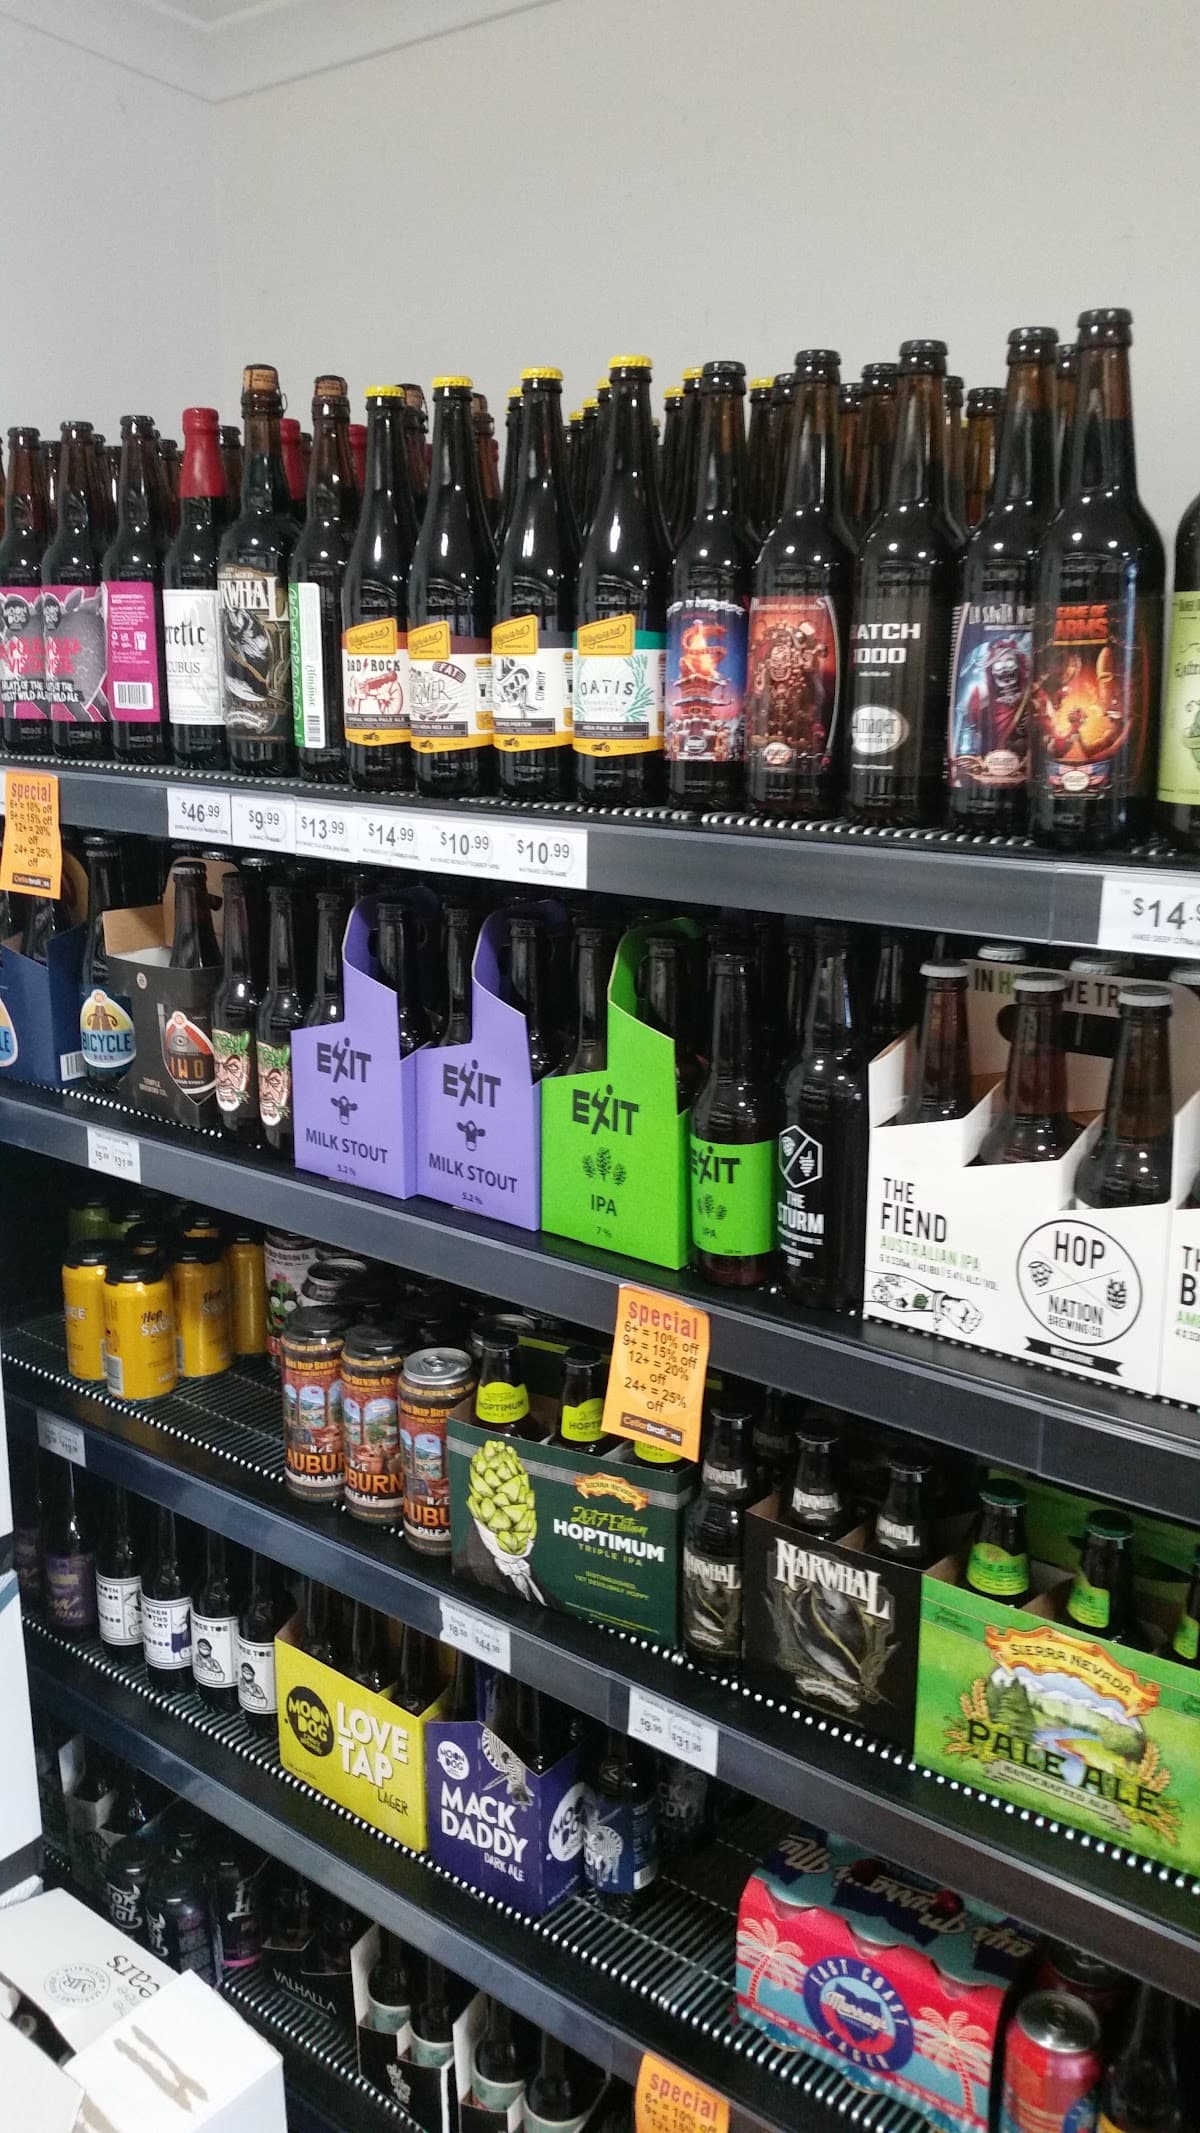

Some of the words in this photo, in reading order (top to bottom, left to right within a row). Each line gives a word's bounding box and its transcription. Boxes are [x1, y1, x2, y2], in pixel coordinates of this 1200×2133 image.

[219, 575, 290, 622] RWHAL
[370, 658, 401, 672] ROCK
[580, 679, 635, 696] OATIS
[11, 781, 51, 803] special
[42, 804, 52, 815] off
[42, 816, 53, 826] off
[181, 801, 221, 823] $46.99
[248, 809, 280, 831] $9.99
[28, 836, 39, 846] off
[301, 816, 345, 839] $13.99
[368, 822, 415, 847] $14.99
[14, 843, 28, 854] 24+
[440, 831, 490, 856] $10.99
[516, 839, 570, 865] $10.99
[28, 858, 39, 867] off
[975, 967, 994, 993] IN
[81, 1032, 132, 1053] BICYCLE
[316, 1037, 372, 1083] EXIT
[442, 1059, 502, 1108] EXIT
[571, 1084, 641, 1136] EXIT
[305, 1127, 340, 1151] MILK
[341, 1138, 388, 1164] STOUT
[428, 1152, 465, 1178] MILK
[467, 1164, 518, 1193] STOUT
[590, 1194, 618, 1217] IPA
[786, 1189, 806, 1209] THE
[882, 1177, 915, 1204] THE
[880, 1202, 947, 1243] FIEND
[880, 1235, 957, 1265] AUSTRALIAN
[1053, 1230, 1105, 1269] HOP
[628, 1300, 698, 1340] special
[1048, 1314, 1089, 1334] BREWING
[1049, 1294, 1104, 1325] NATION
[623, 1334, 638, 1346] 9+
[652, 1344, 677, 1363] 15%
[680, 1355, 698, 1370] off
[624, 1321, 639, 1332] 6+
[653, 1330, 678, 1349] 10%
[682, 1342, 700, 1356] off
[628, 1350, 650, 1365] 12+
[665, 1362, 689, 1382] 20%
[649, 1373, 667, 1386] off
[623, 1376, 647, 1392] 24+
[661, 1389, 687, 1409] 25%
[646, 1400, 665, 1414] off
[553, 1518, 666, 1563] HOPTIMUM
[576, 1542, 618, 1560] TRIPLE
[622, 1555, 643, 1567] IPA
[774, 1537, 892, 1620] NARWHAL
[1008, 1642, 1068, 1661] SIERRA
[1070, 1654, 1133, 1697] NEVADA
[288, 1696, 330, 1729] MOON
[298, 1717, 328, 1742] DOG
[336, 1701, 409, 1765] LOVE
[338, 1737, 394, 1790] TAP
[440, 1747, 465, 1763] MOON
[445, 1757, 464, 1772] DOG
[967, 1718, 1067, 1780] PALE
[1081, 1764, 1163, 1817] ALE
[377, 1788, 409, 1817] LAGER
[440, 1780, 517, 1833] MACK
[440, 1808, 529, 1864] DADDY
[483, 1851, 507, 1876] DARK
[507, 1864, 526, 1883] ALE
[809, 1958, 850, 1987] EAST
[860, 1966, 910, 2027] COAST
[825, 2030, 890, 2070] LAGER
[649, 2072, 719, 2122] special
